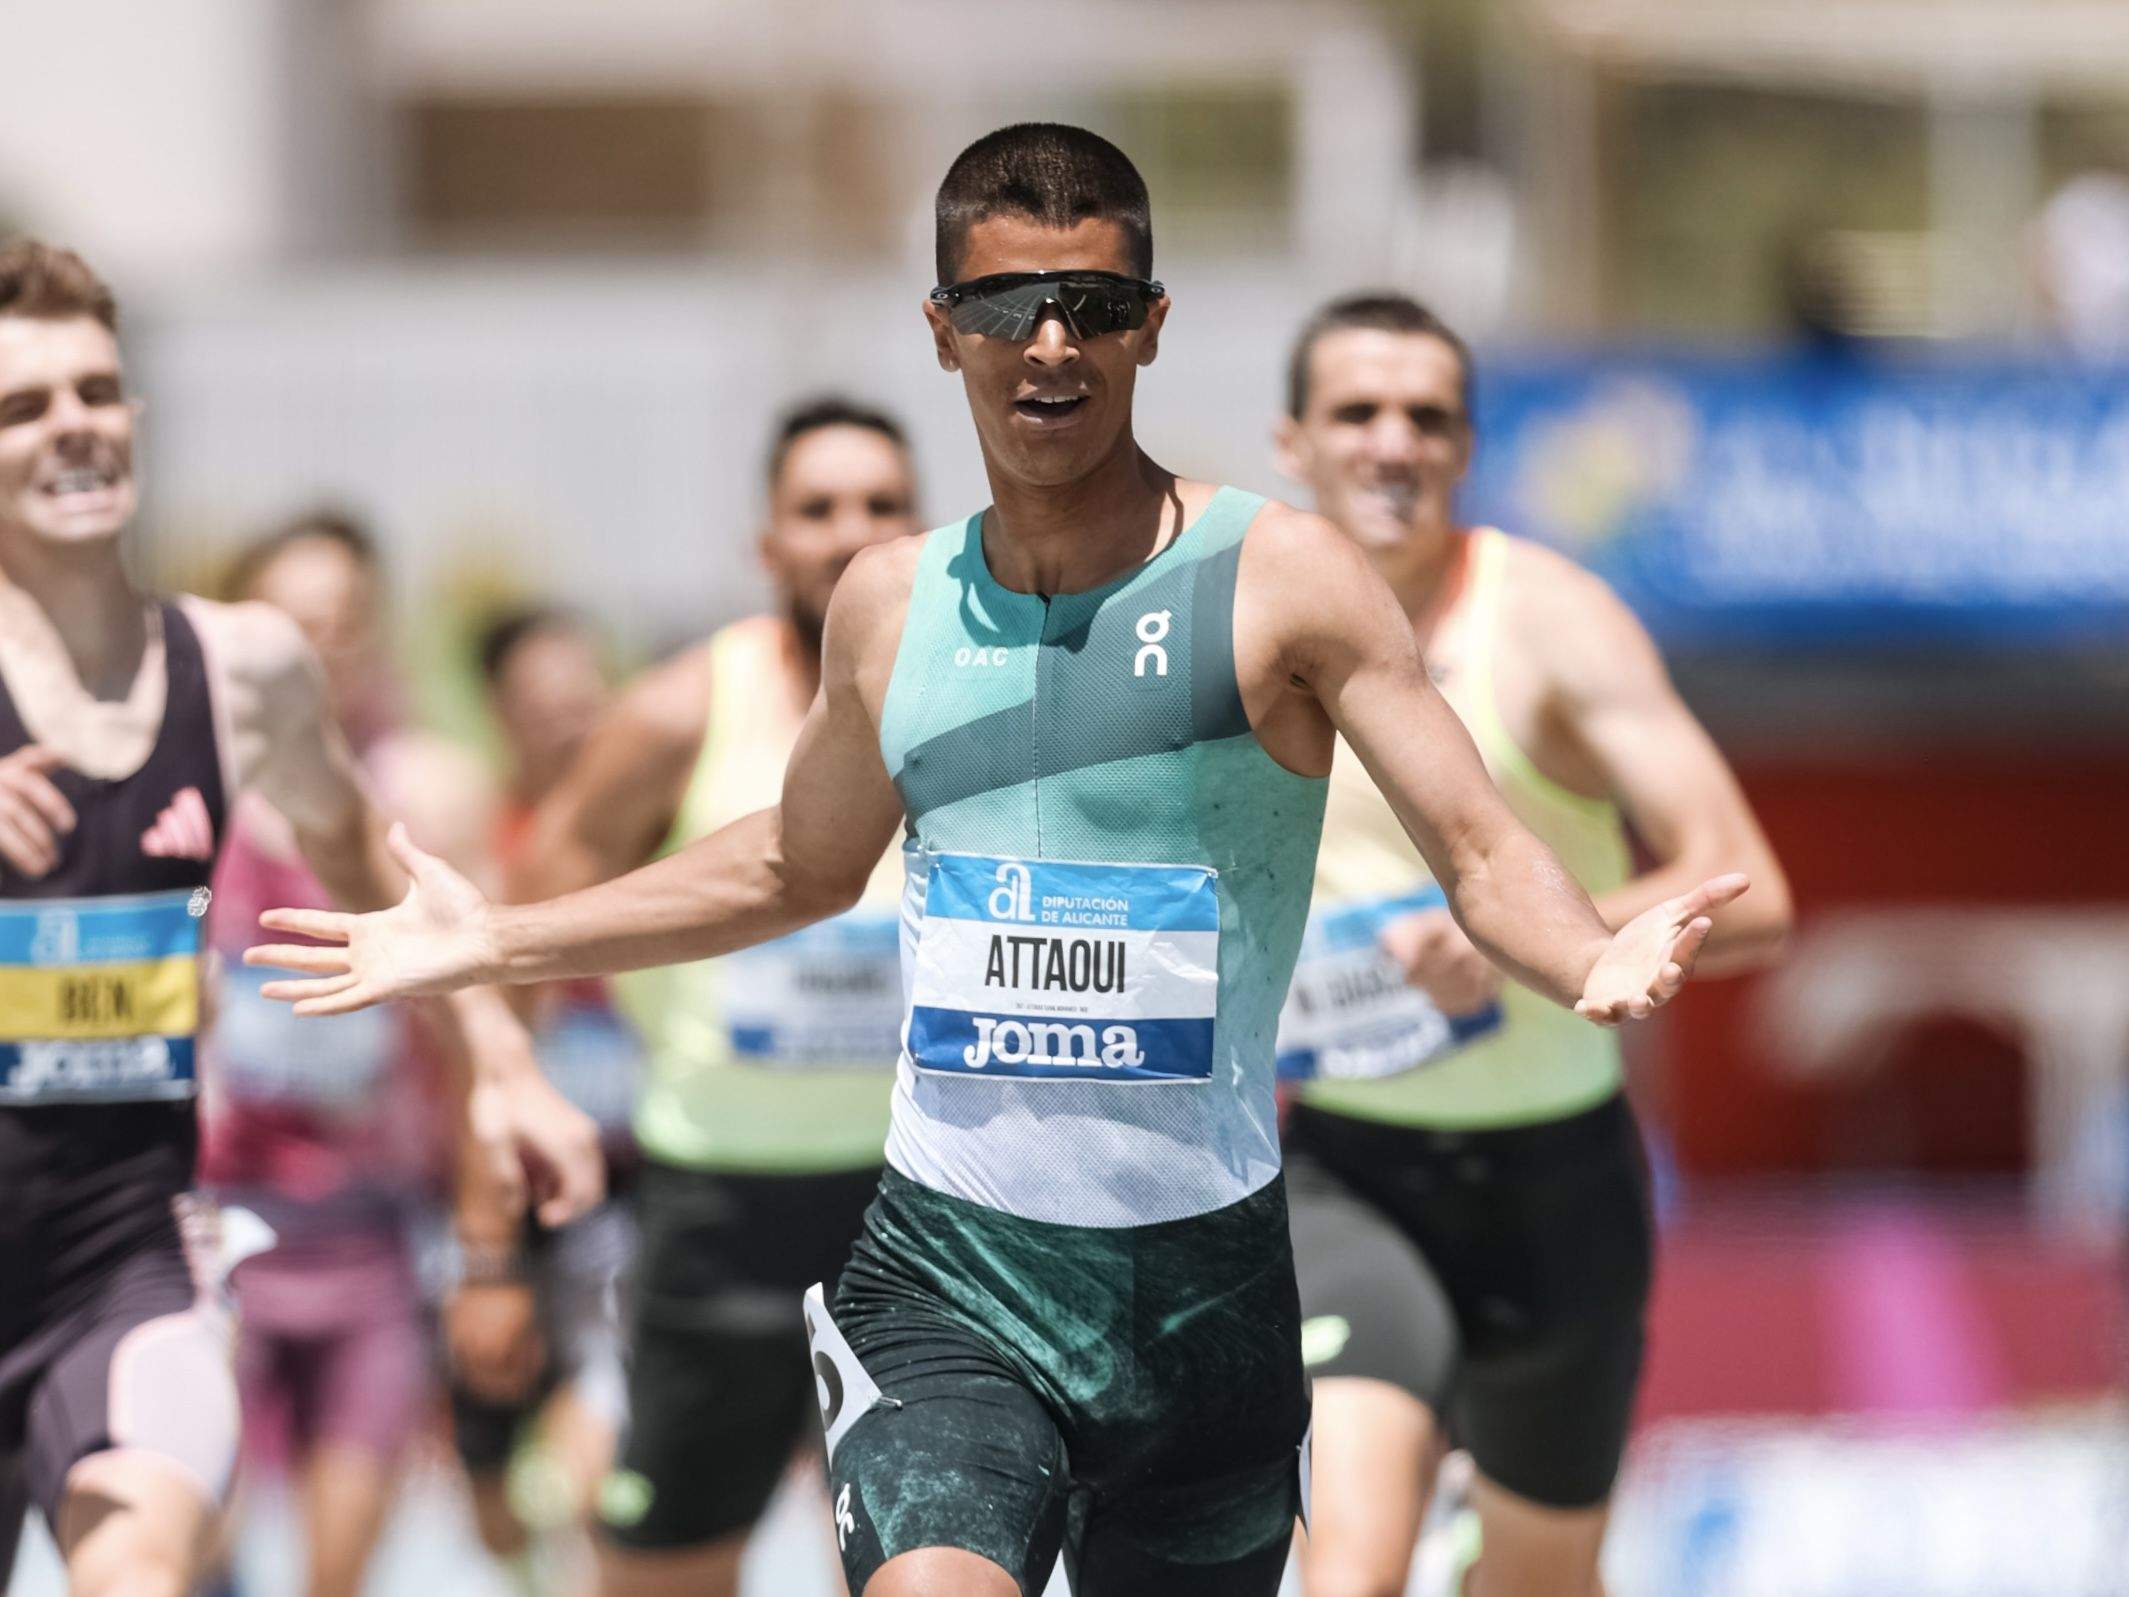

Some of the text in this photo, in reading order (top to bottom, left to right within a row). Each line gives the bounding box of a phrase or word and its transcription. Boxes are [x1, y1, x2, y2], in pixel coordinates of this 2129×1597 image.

[954, 647, 1009, 667] OAC
[1042, 896, 1129, 912] DIPUTACIÓN
[1041, 911, 1128, 926] DE ALICANTE
[985, 934, 1126, 993] ATTAOUI
